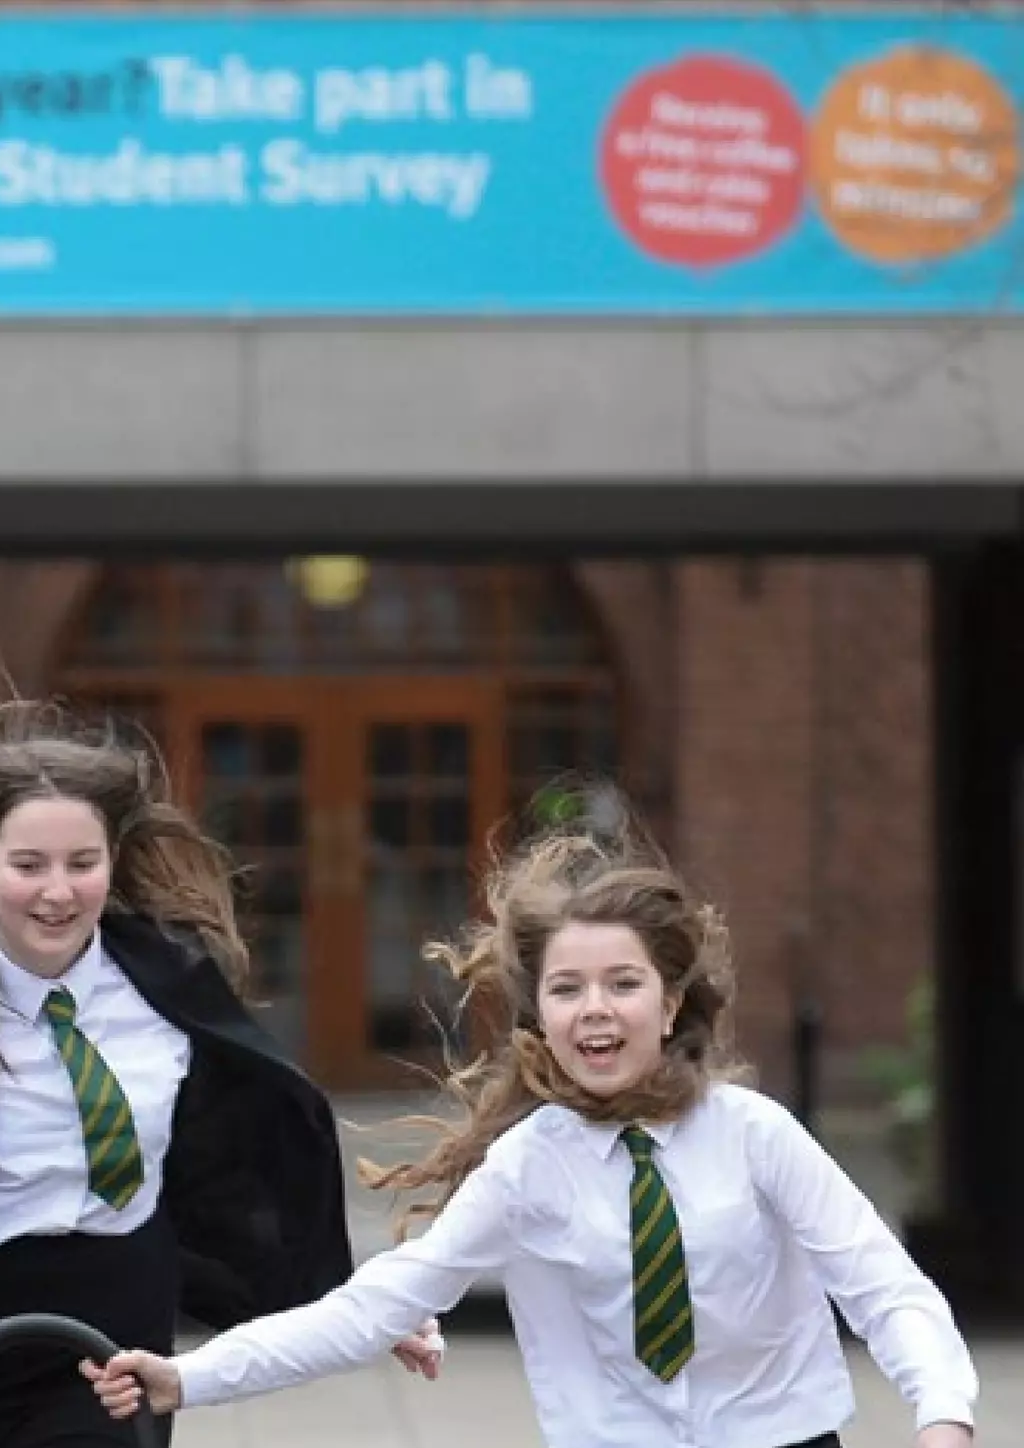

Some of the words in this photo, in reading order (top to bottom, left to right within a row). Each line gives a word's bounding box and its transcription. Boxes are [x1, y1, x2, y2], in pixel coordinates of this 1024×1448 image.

[152, 55, 304, 120] Take
[314, 56, 454, 133] part
[466, 53, 532, 120] in
[260, 136, 492, 220] Survey
